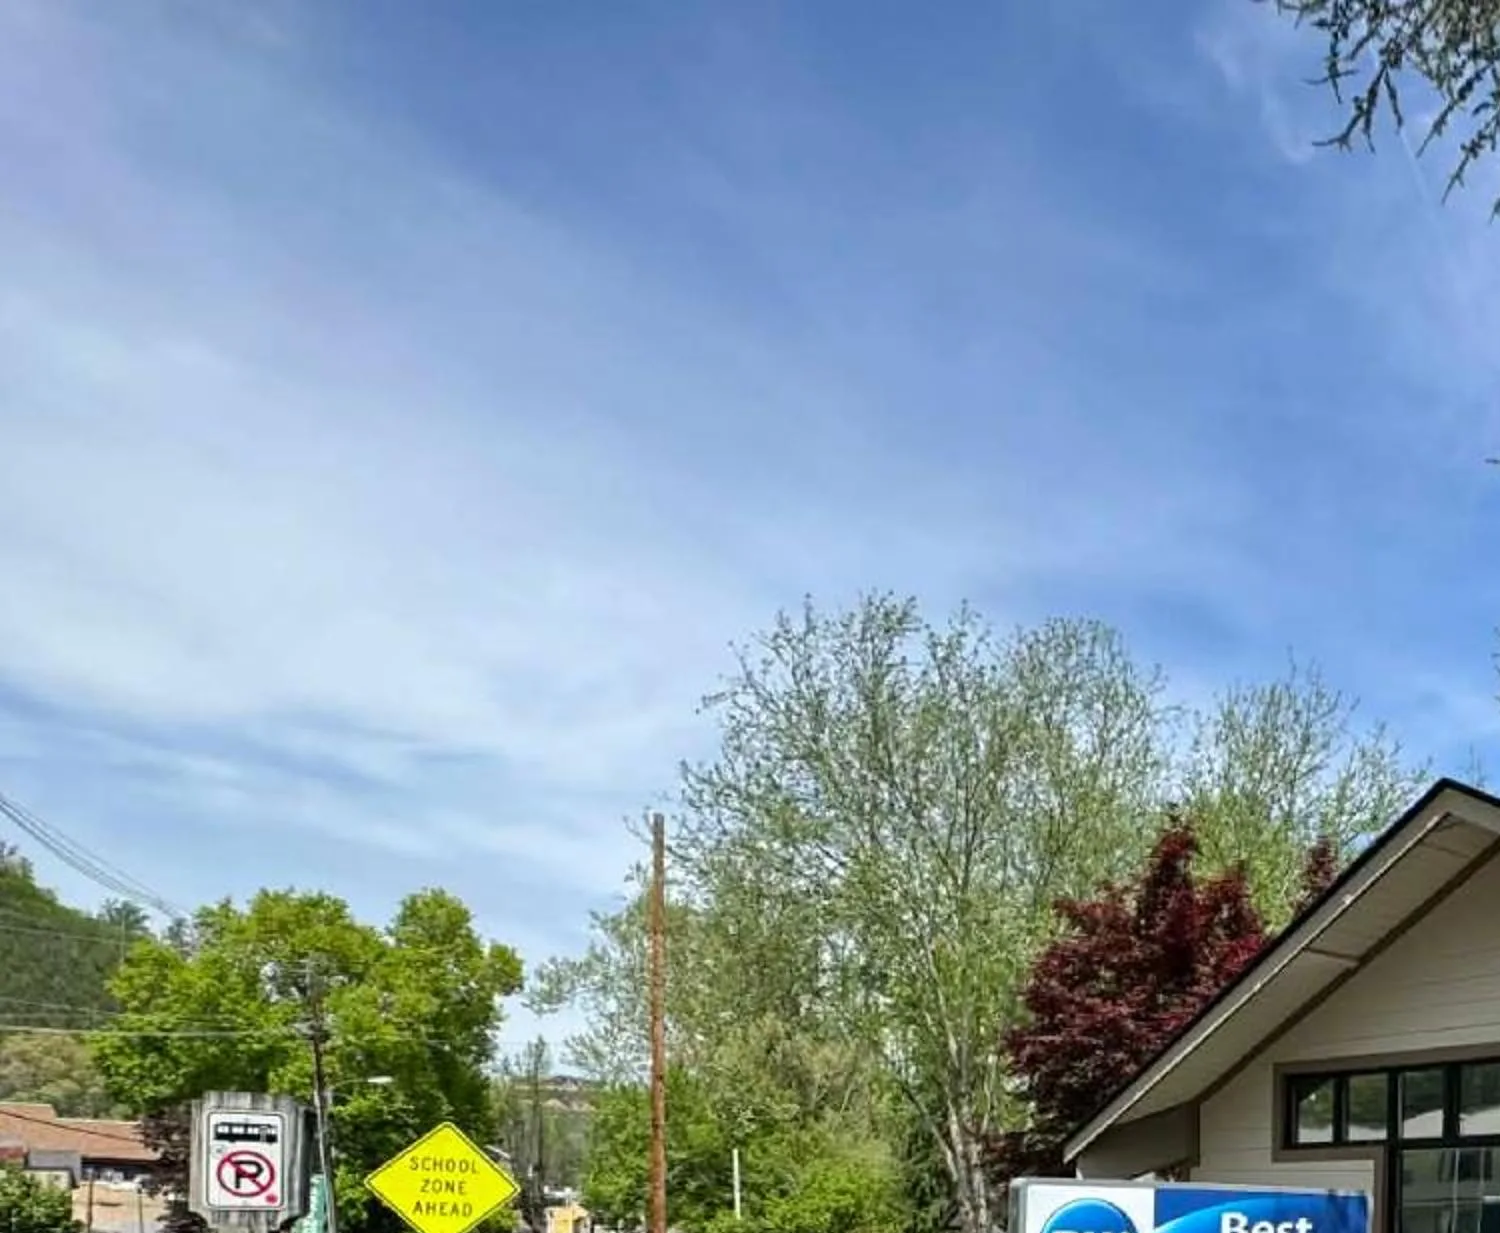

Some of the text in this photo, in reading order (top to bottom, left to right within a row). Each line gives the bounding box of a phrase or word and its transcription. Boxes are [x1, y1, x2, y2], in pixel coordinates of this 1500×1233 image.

[409, 1156, 479, 1174] SCHOOL
[420, 1179, 467, 1195] ZONE
[412, 1200, 473, 1217] AHEAD
